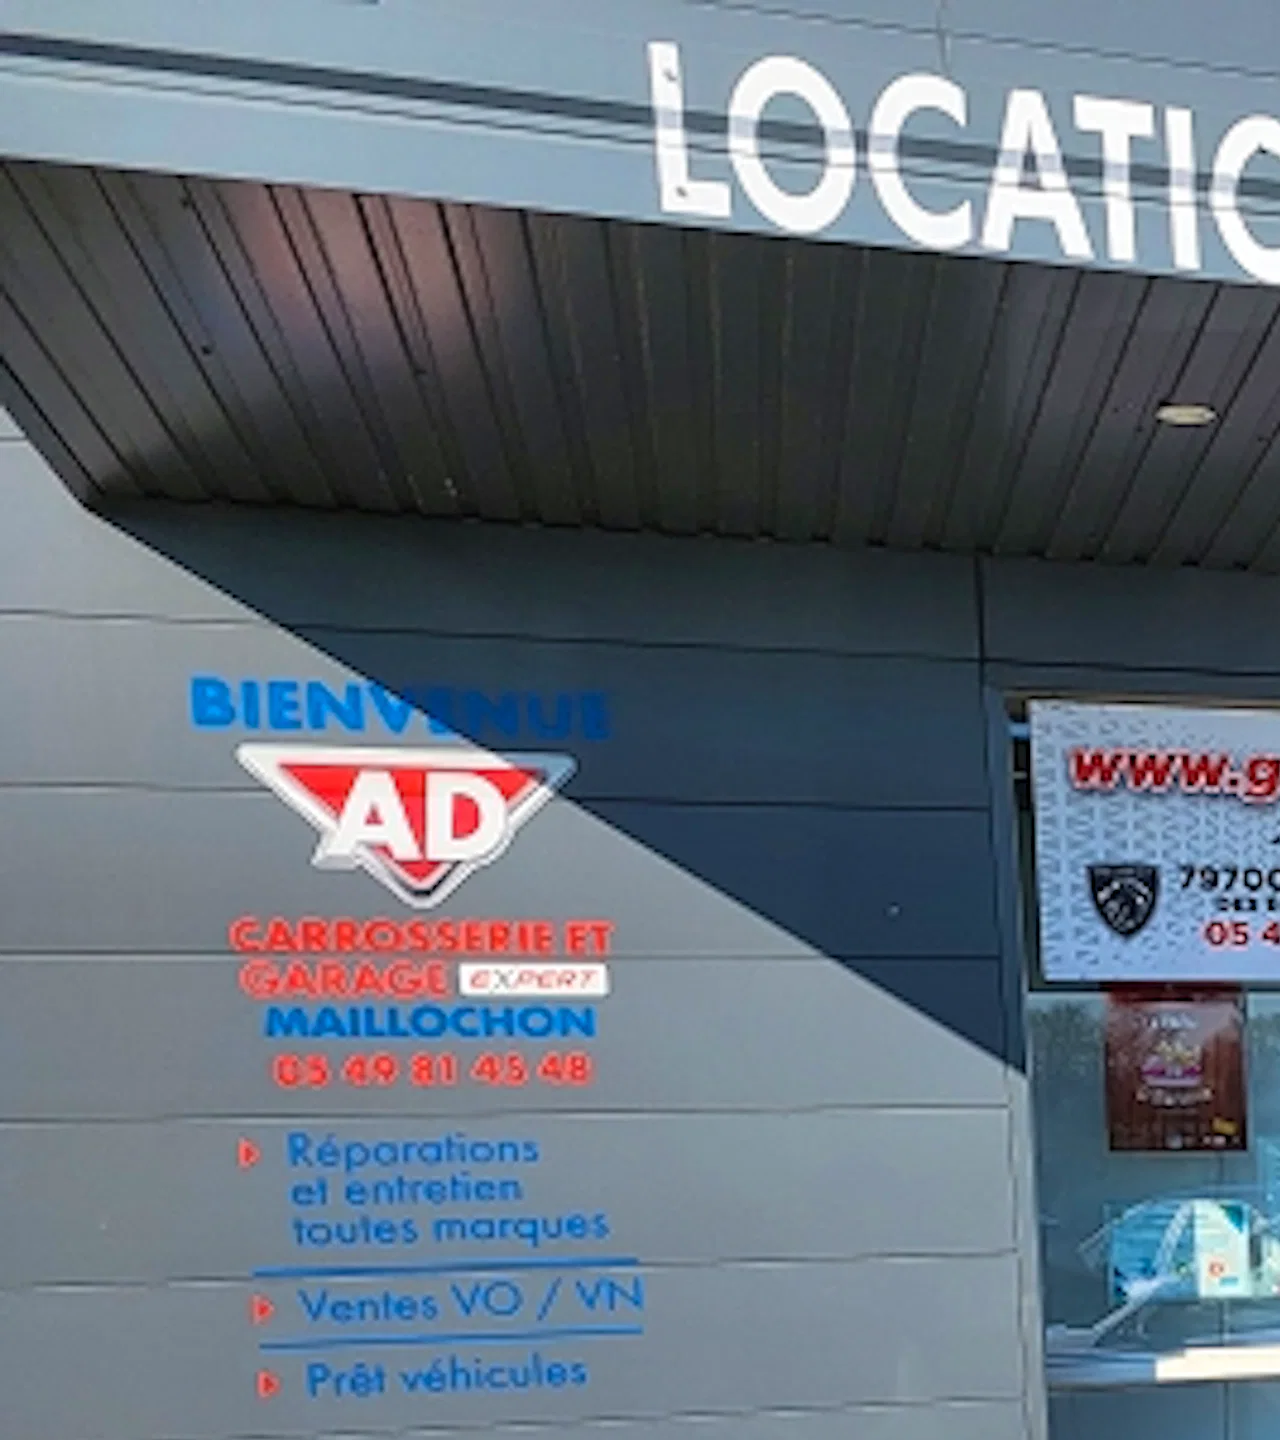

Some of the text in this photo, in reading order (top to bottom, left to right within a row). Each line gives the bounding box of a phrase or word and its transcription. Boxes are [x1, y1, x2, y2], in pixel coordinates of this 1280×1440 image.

[190, 675, 613, 740] BIENVENUE
[324, 769, 507, 862] AD
[228, 917, 616, 955] CARROSSERIE ET
[1204, 921, 1250, 947] 05
[239, 959, 449, 1000] GARAGE
[264, 1006, 596, 1039] MAILLOCHON
[272, 1051, 592, 1090] 05 49 81 45 48
[287, 1131, 540, 1172] Réparations
[290, 1171, 523, 1206] et entretien
[294, 1211, 611, 1248] toutes marques
[299, 1288, 439, 1322] Ventes
[450, 1280, 523, 1318] VO
[575, 1275, 645, 1312] VN
[306, 1352, 589, 1400] Prêt véhicules
